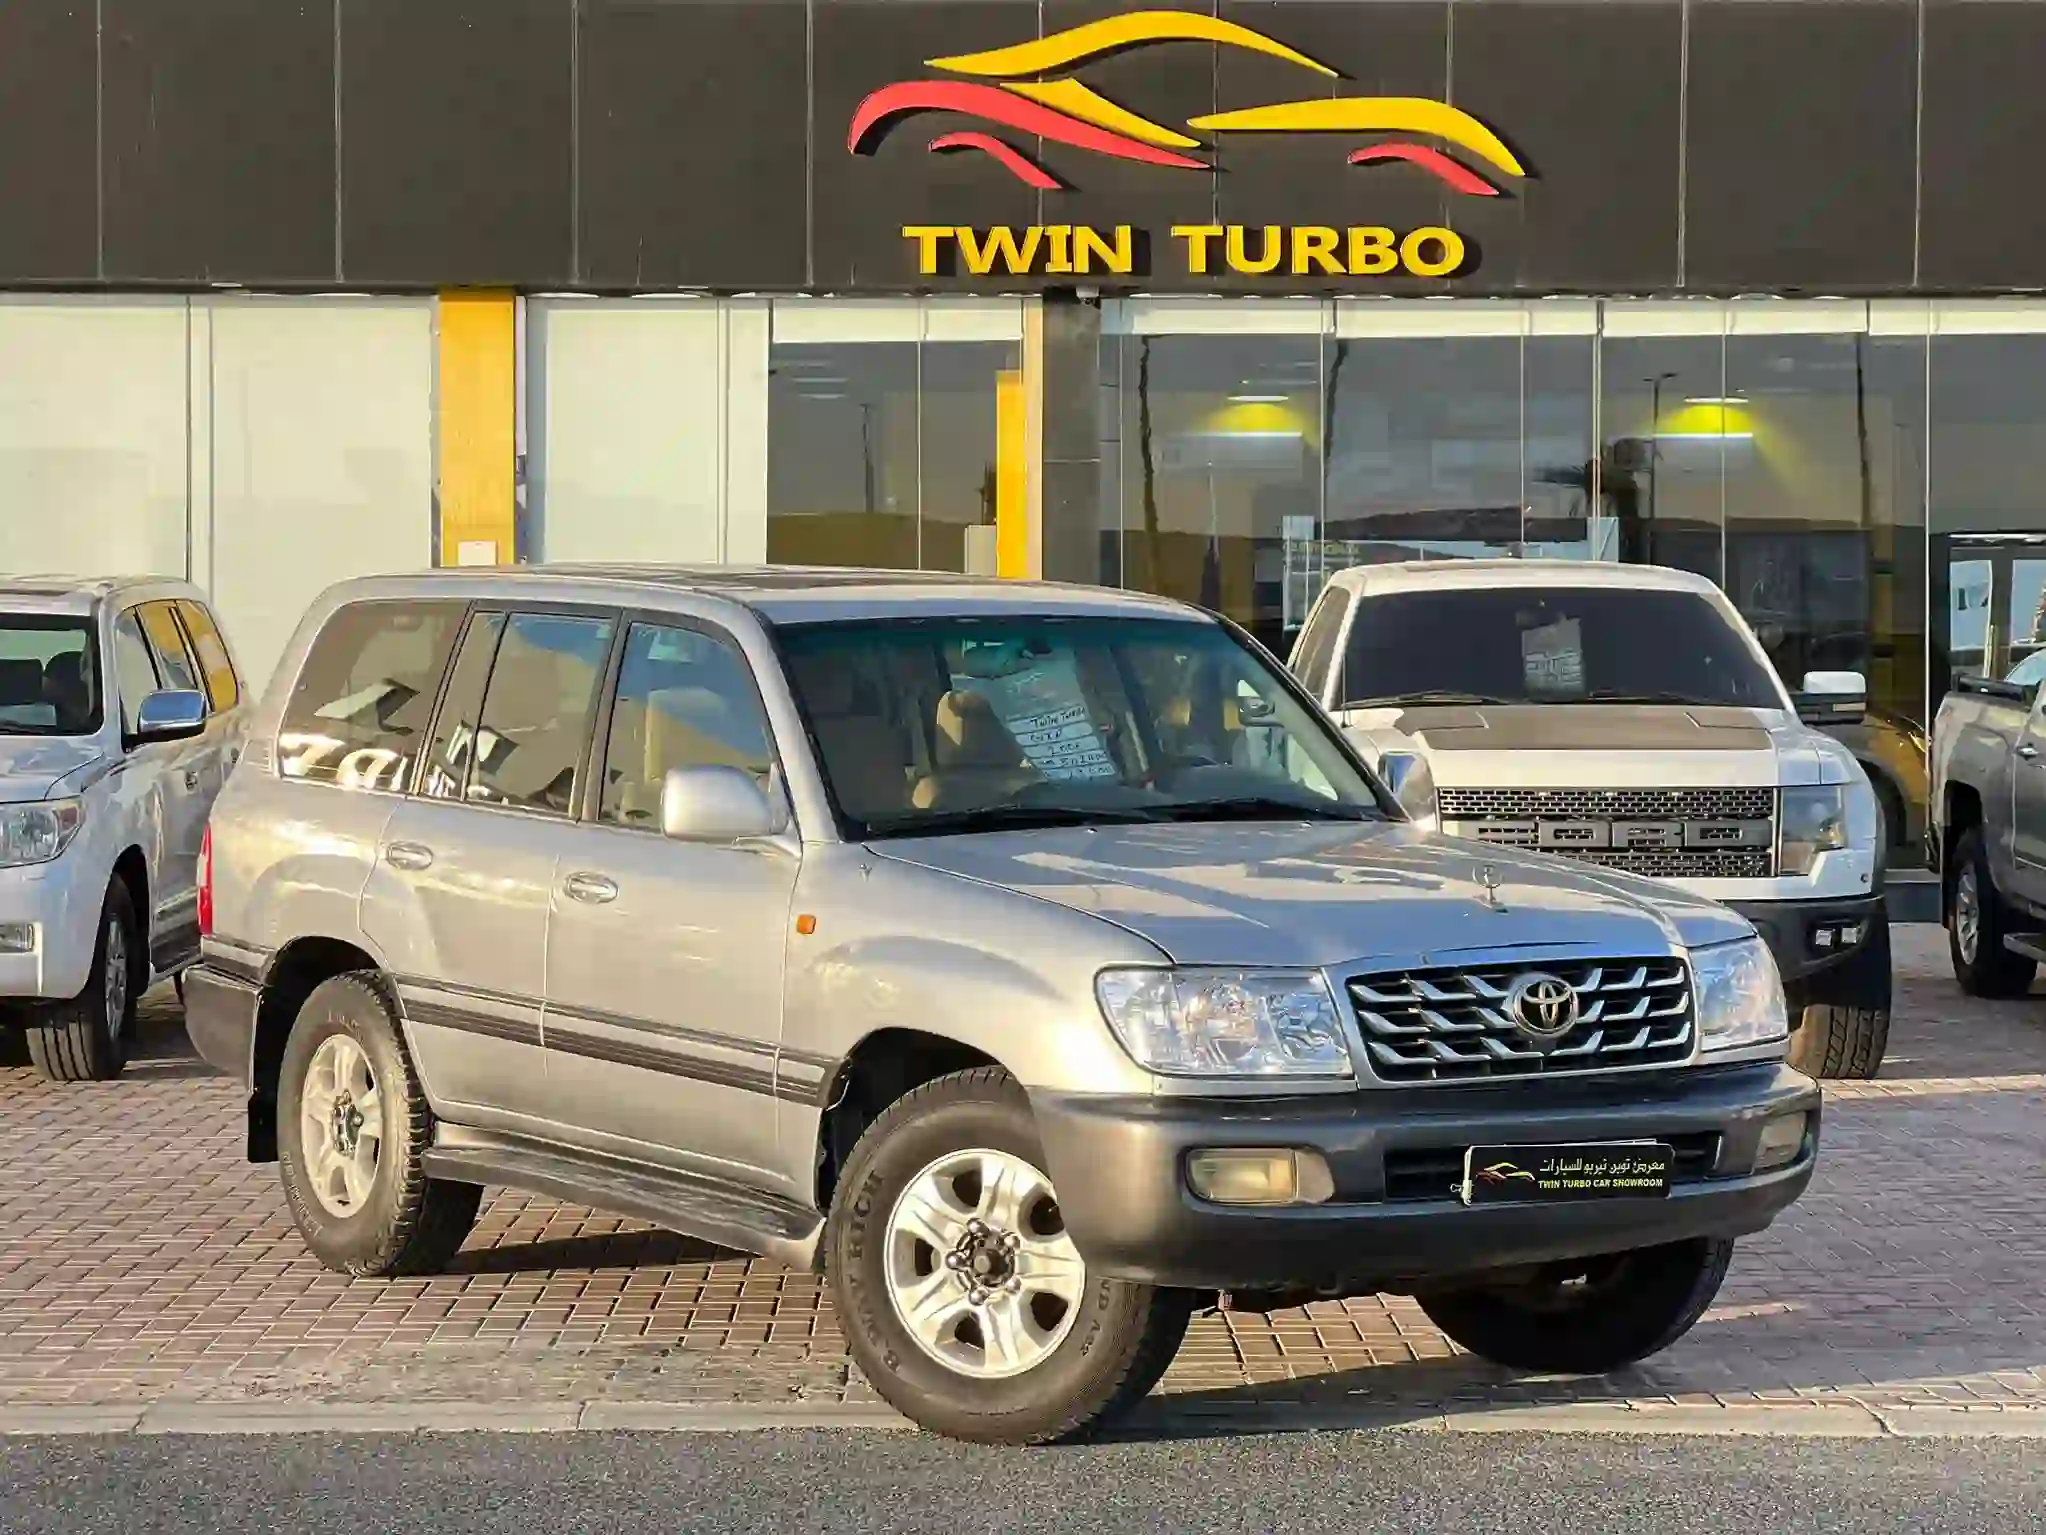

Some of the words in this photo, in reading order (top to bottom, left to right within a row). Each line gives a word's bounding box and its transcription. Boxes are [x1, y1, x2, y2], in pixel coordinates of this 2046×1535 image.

[902, 224, 1132, 275] TWIN
[1171, 224, 1465, 277] TURBO
[1441, 819, 1773, 850] FORD
[1539, 1157, 1583, 1175] للسيارات
[1608, 1158, 1631, 1174] توين
[1632, 1157, 1665, 1174] معرض
[1537, 1179, 1560, 1188] TWIN
[1562, 1179, 1592, 1188] TURBO
[1593, 1179, 1611, 1187] CAR
[1612, 1178, 1663, 1188] SHOWROOM
